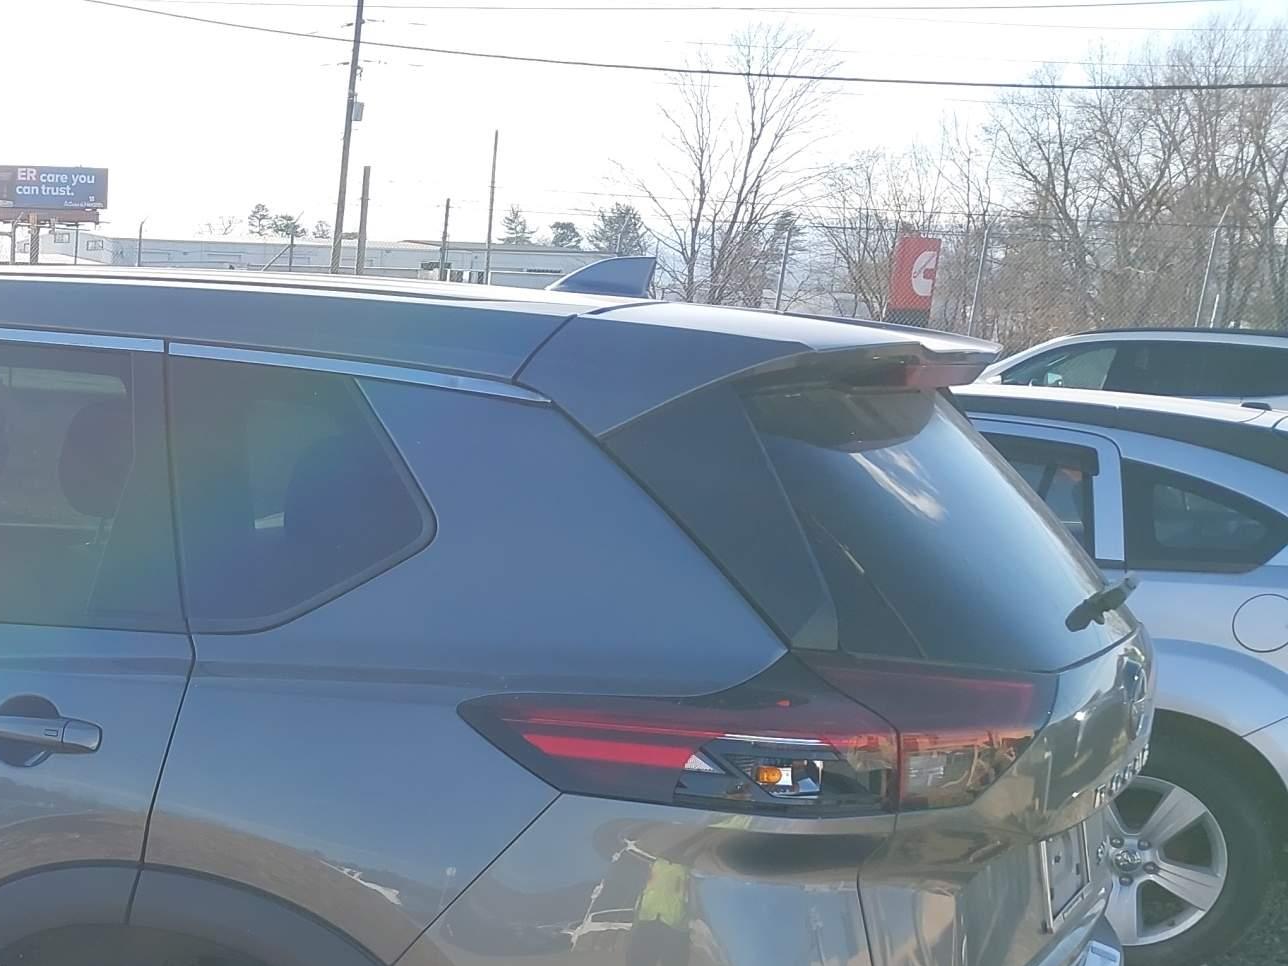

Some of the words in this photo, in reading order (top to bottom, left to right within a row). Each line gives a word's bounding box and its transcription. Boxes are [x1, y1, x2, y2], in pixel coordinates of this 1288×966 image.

[17, 167, 37, 181] ER
[40, 172, 68, 184] care
[71, 173, 95, 185] you
[15, 184, 39, 195] can
[41, 184, 74, 196] trust.
